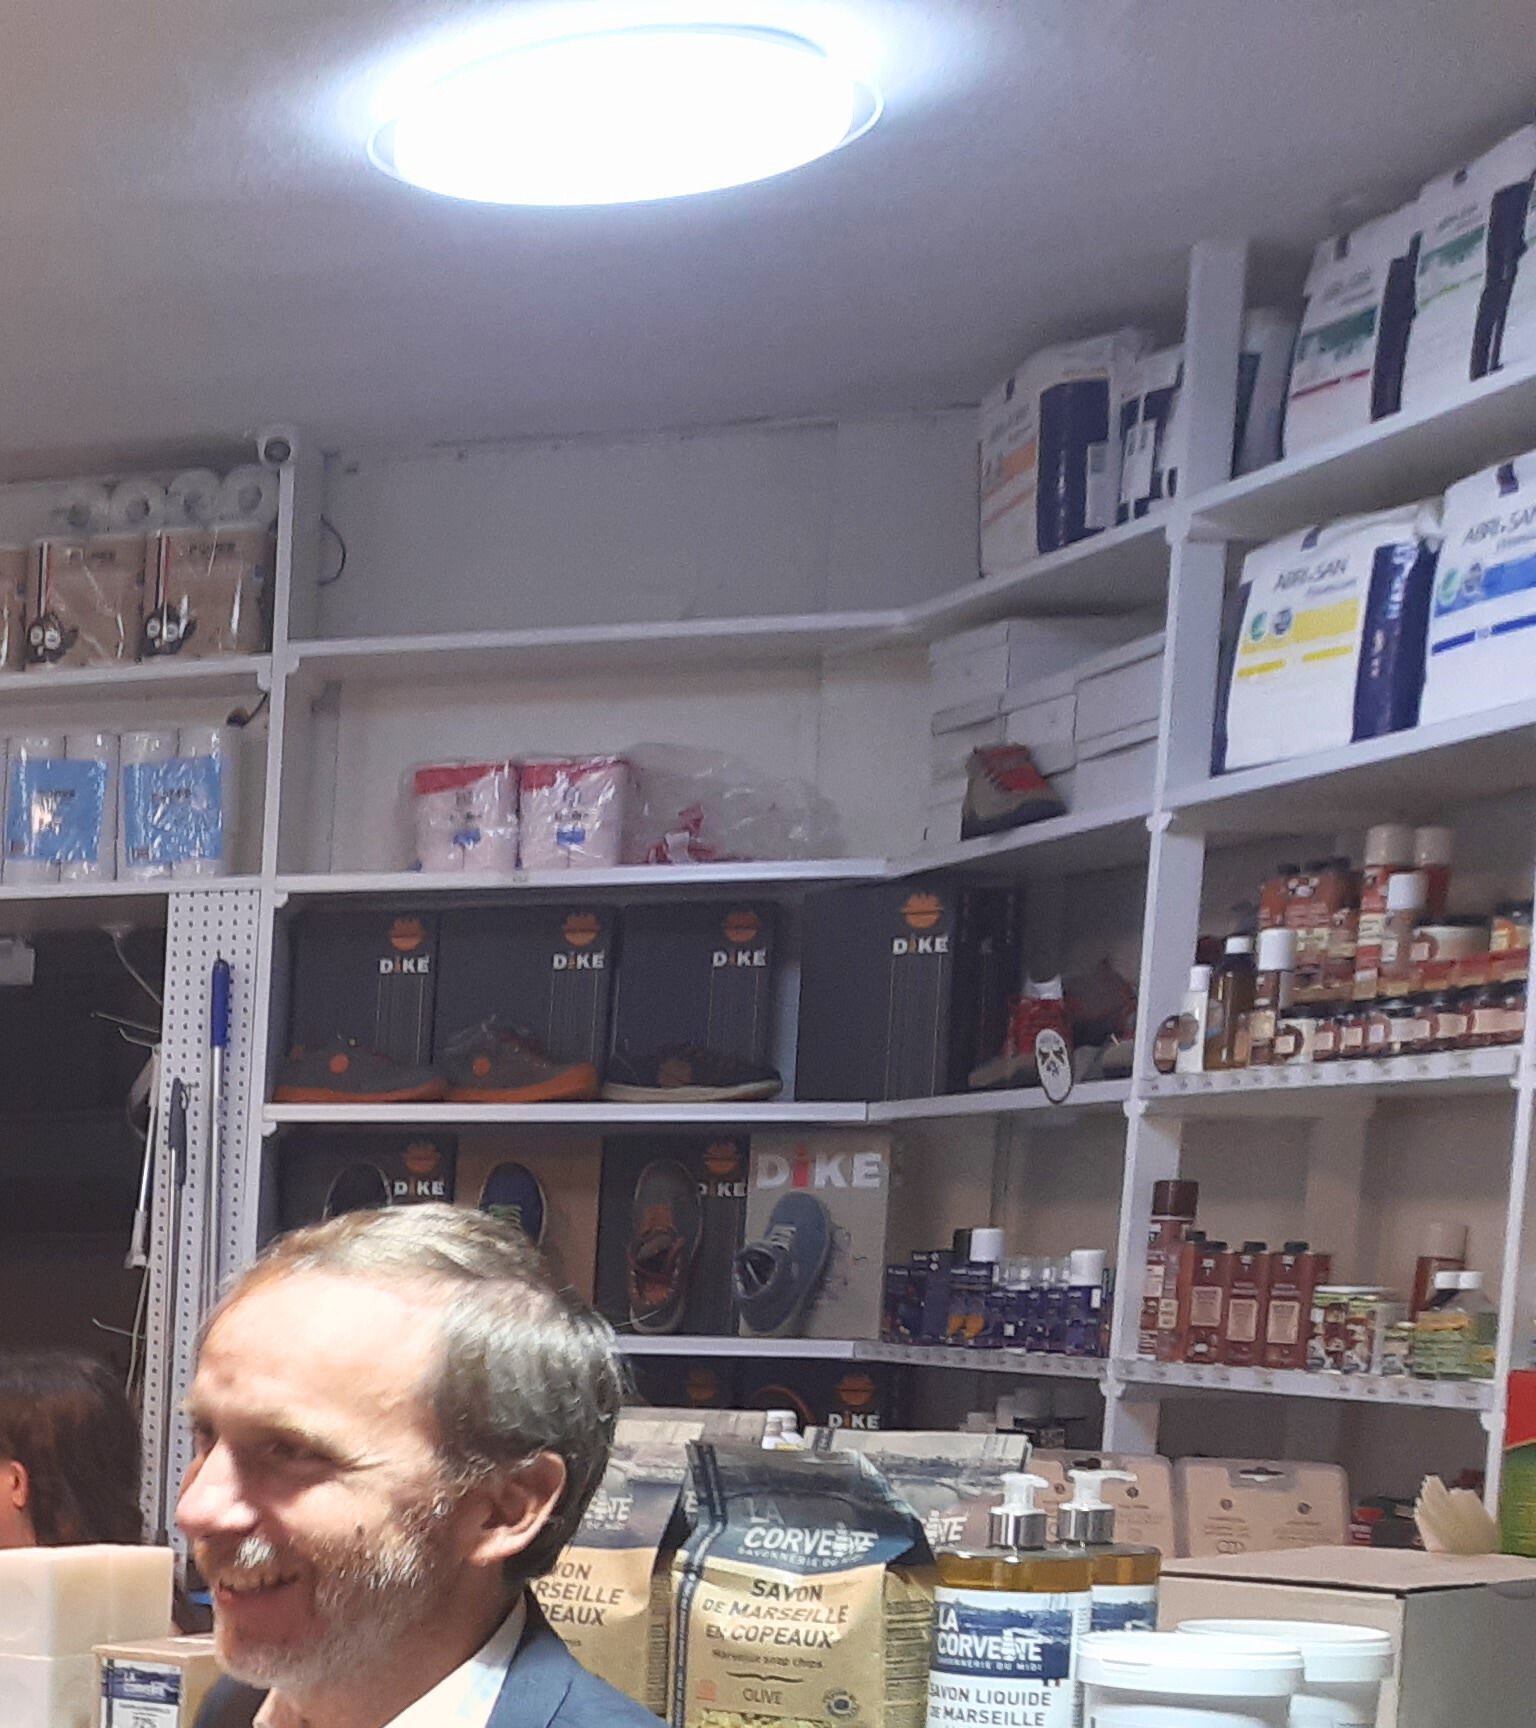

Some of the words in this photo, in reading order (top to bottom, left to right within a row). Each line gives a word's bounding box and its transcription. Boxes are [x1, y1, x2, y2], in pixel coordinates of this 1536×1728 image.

[535, 1580, 625, 1606] RSEILLE
[750, 1578, 823, 1602] SAVON
[702, 1598, 724, 1613] DE
[727, 1600, 850, 1625] MARSEILLE
[938, 1607, 960, 1633] LA
[730, 1624, 834, 1650] COPEAUX
[742, 1687, 784, 1705] OLIVE
[929, 1682, 970, 1703] SAVON
[975, 1689, 1052, 1707] LIQUIDE
[942, 1705, 1046, 1727] MARSEILLE
